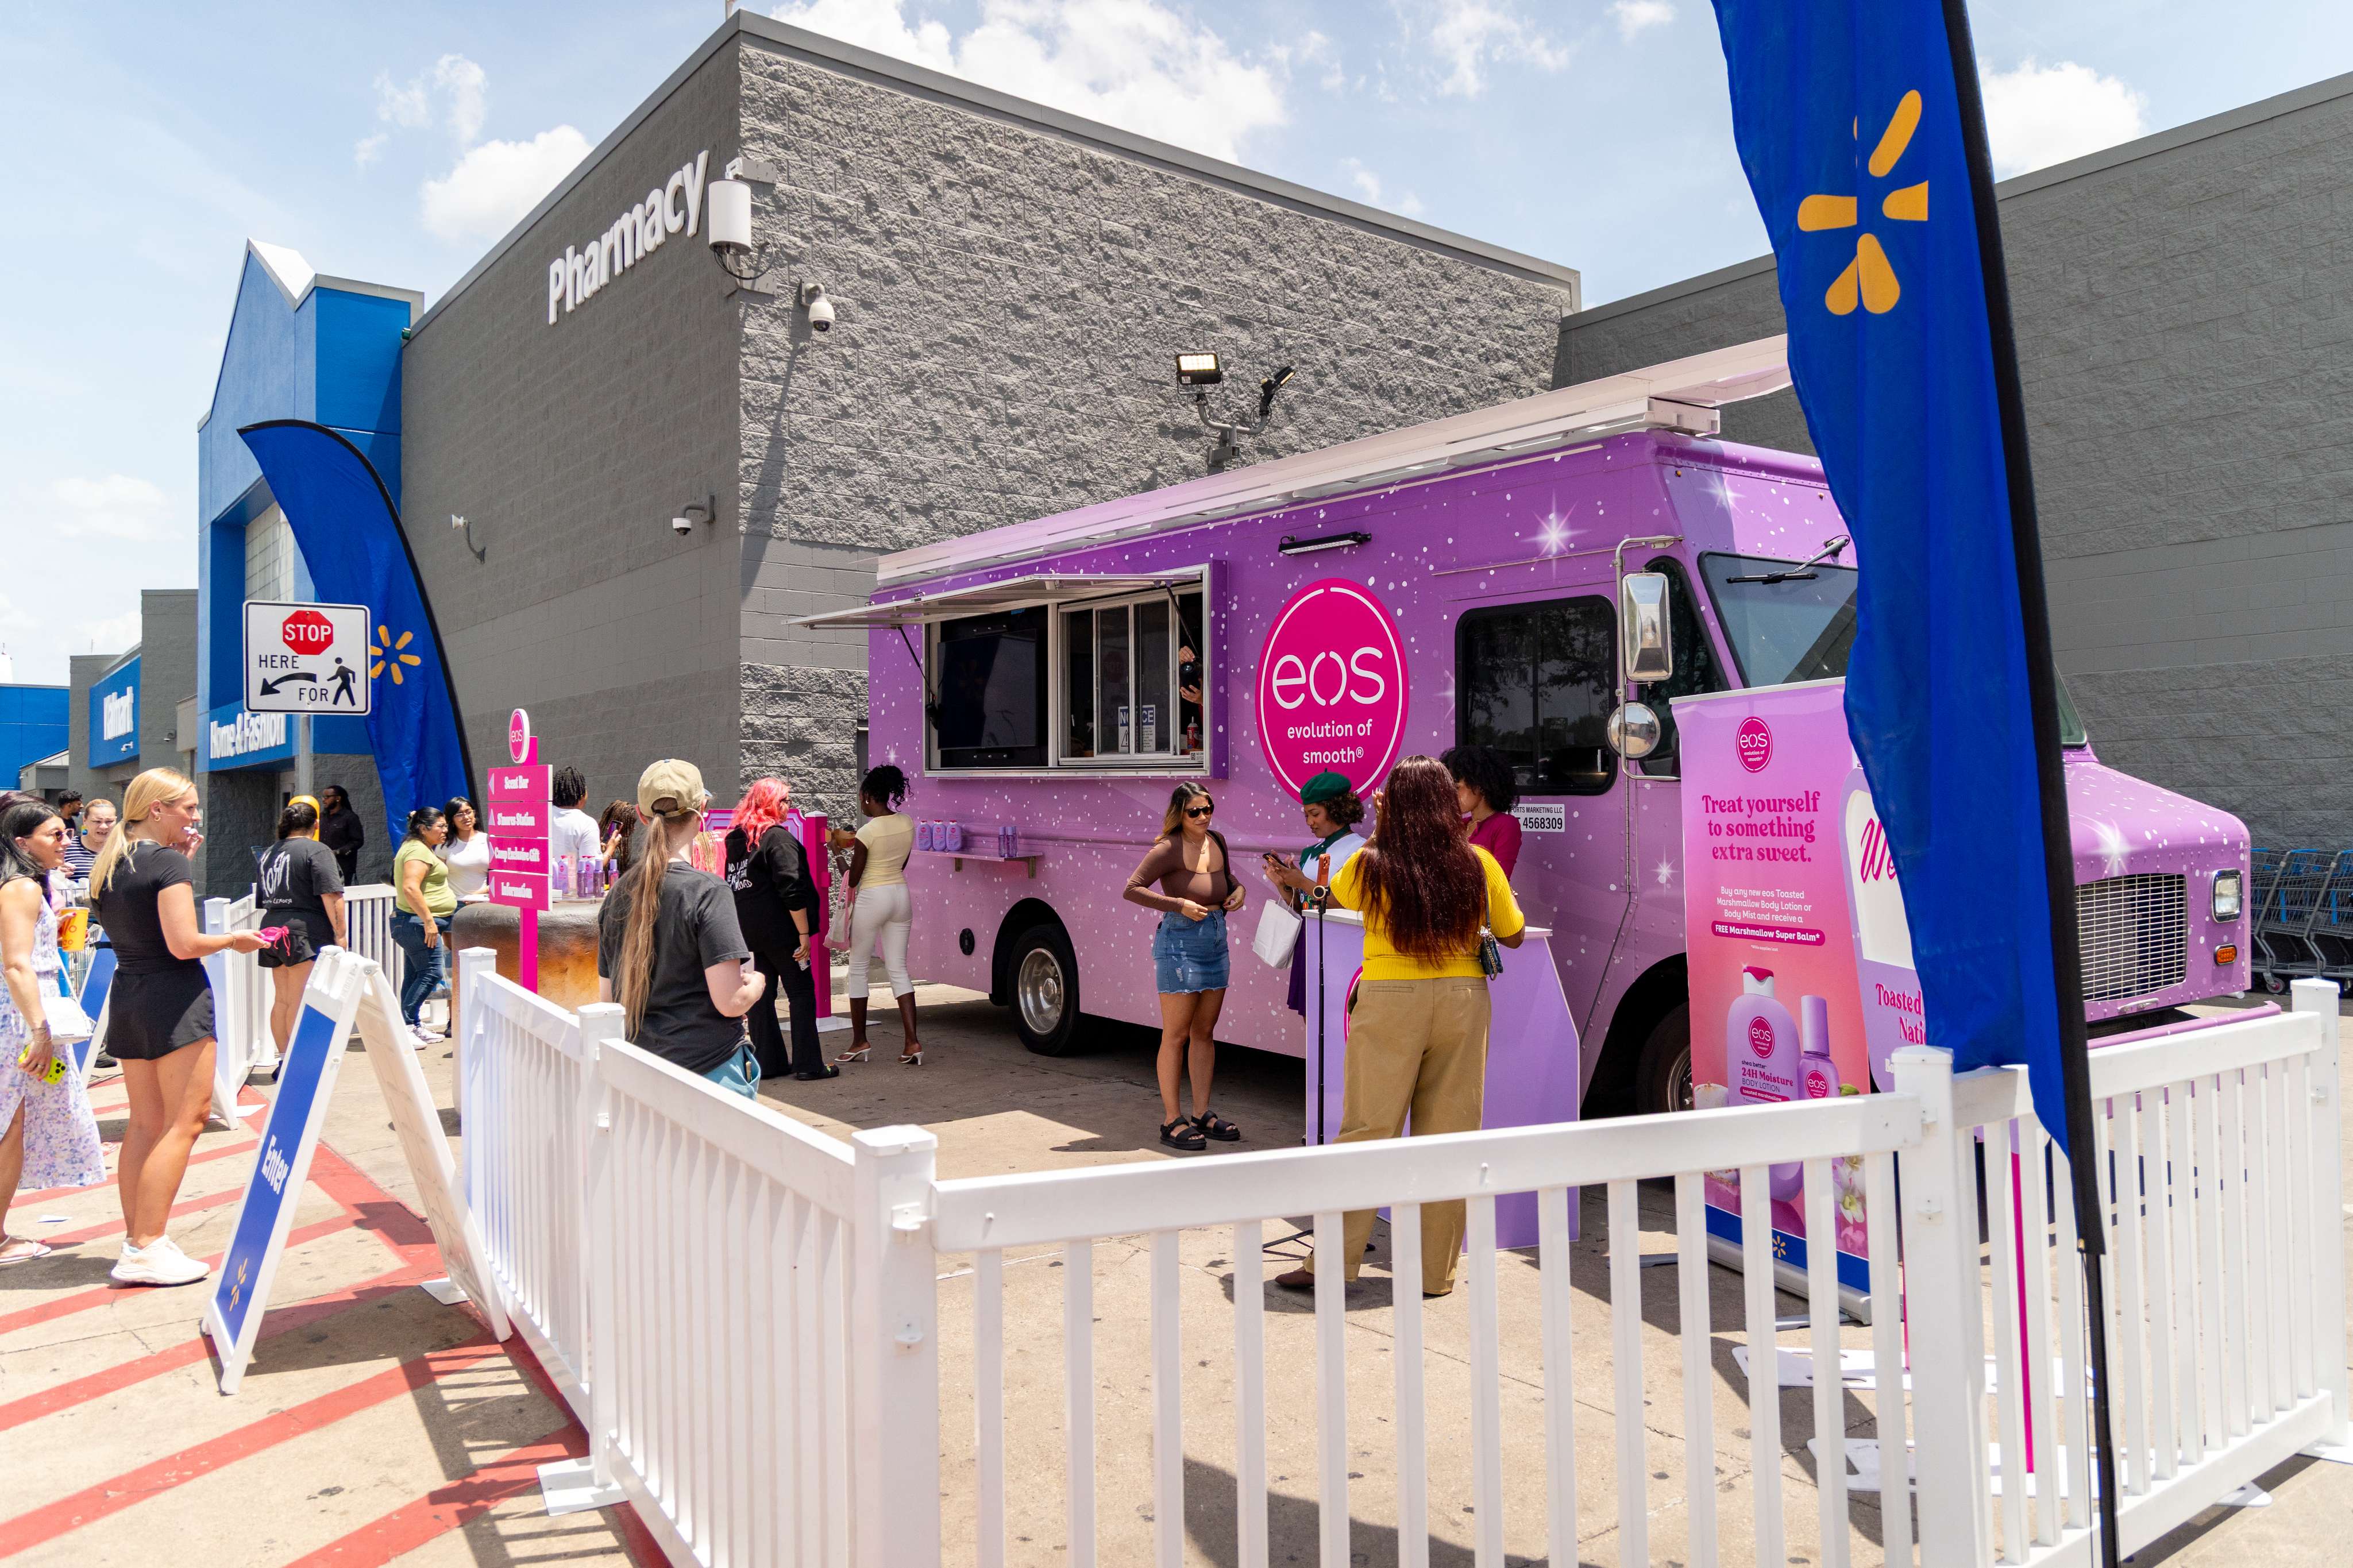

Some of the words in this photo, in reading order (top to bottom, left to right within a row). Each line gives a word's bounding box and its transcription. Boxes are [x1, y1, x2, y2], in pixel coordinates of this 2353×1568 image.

[549, 150, 709, 325] Pharmacy
[284, 624, 331, 642] STOP
[259, 654, 299, 669] HERE
[1272, 647, 1385, 709] eos
[299, 688, 329, 701] FOR
[104, 686, 133, 740] Walmart
[1120, 709, 1154, 724] NTCE
[210, 720, 236, 759] Home
[236, 713, 244, 755] &
[244, 712, 286, 752] Fashion
[511, 729, 523, 743] eos
[1287, 720, 1353, 739] evolution
[1357, 719, 1373, 736] of
[1740, 733, 1768, 748] eos
[504, 776, 518, 789] Scent
[518, 775, 529, 789] Bar
[1702, 795, 1743, 813] Treat
[1746, 790, 1820, 818] yourself
[516, 812, 535, 827] Station
[1523, 817, 1563, 829] 4568309
[1708, 820, 1722, 836] to
[1726, 816, 1815, 843] something
[495, 847, 507, 863] Camp
[507, 846, 529, 861] Exclusive
[529, 848, 540, 862] Gift
[1712, 843, 1753, 860] extra
[1757, 844, 1811, 862] sweet.
[501, 882, 533, 898] Information
[1721, 886, 1733, 897] Buy
[1734, 889, 1748, 898] any
[1776, 889, 1804, 899] Toasted
[1716, 897, 1760, 908] Marshmallow
[1761, 900, 1779, 912] Body
[1781, 901, 1802, 911] Lotion
[1724, 909, 1741, 920] Body
[1742, 910, 1756, 919] Mist
[1772, 913, 1796, 922] receive
[1715, 924, 1728, 933] FREE
[1729, 926, 1775, 938] Marshmallow
[1775, 930, 1795, 941] Super
[1876, 983, 1923, 1015] Toasted
[1752, 1028, 1771, 1041] eos
[1899, 1017, 1927, 1045] Nati
[1742, 1067, 1758, 1079] 24H
[1759, 1070, 1793, 1087] Moisture
[1742, 1078, 1759, 1087] BODY
[1760, 1082, 1780, 1092] LOTION
[1808, 1079, 1825, 1089] eos
[1757, 1092, 1782, 1101] marshmallow
[261, 1134, 289, 1195] Enter
